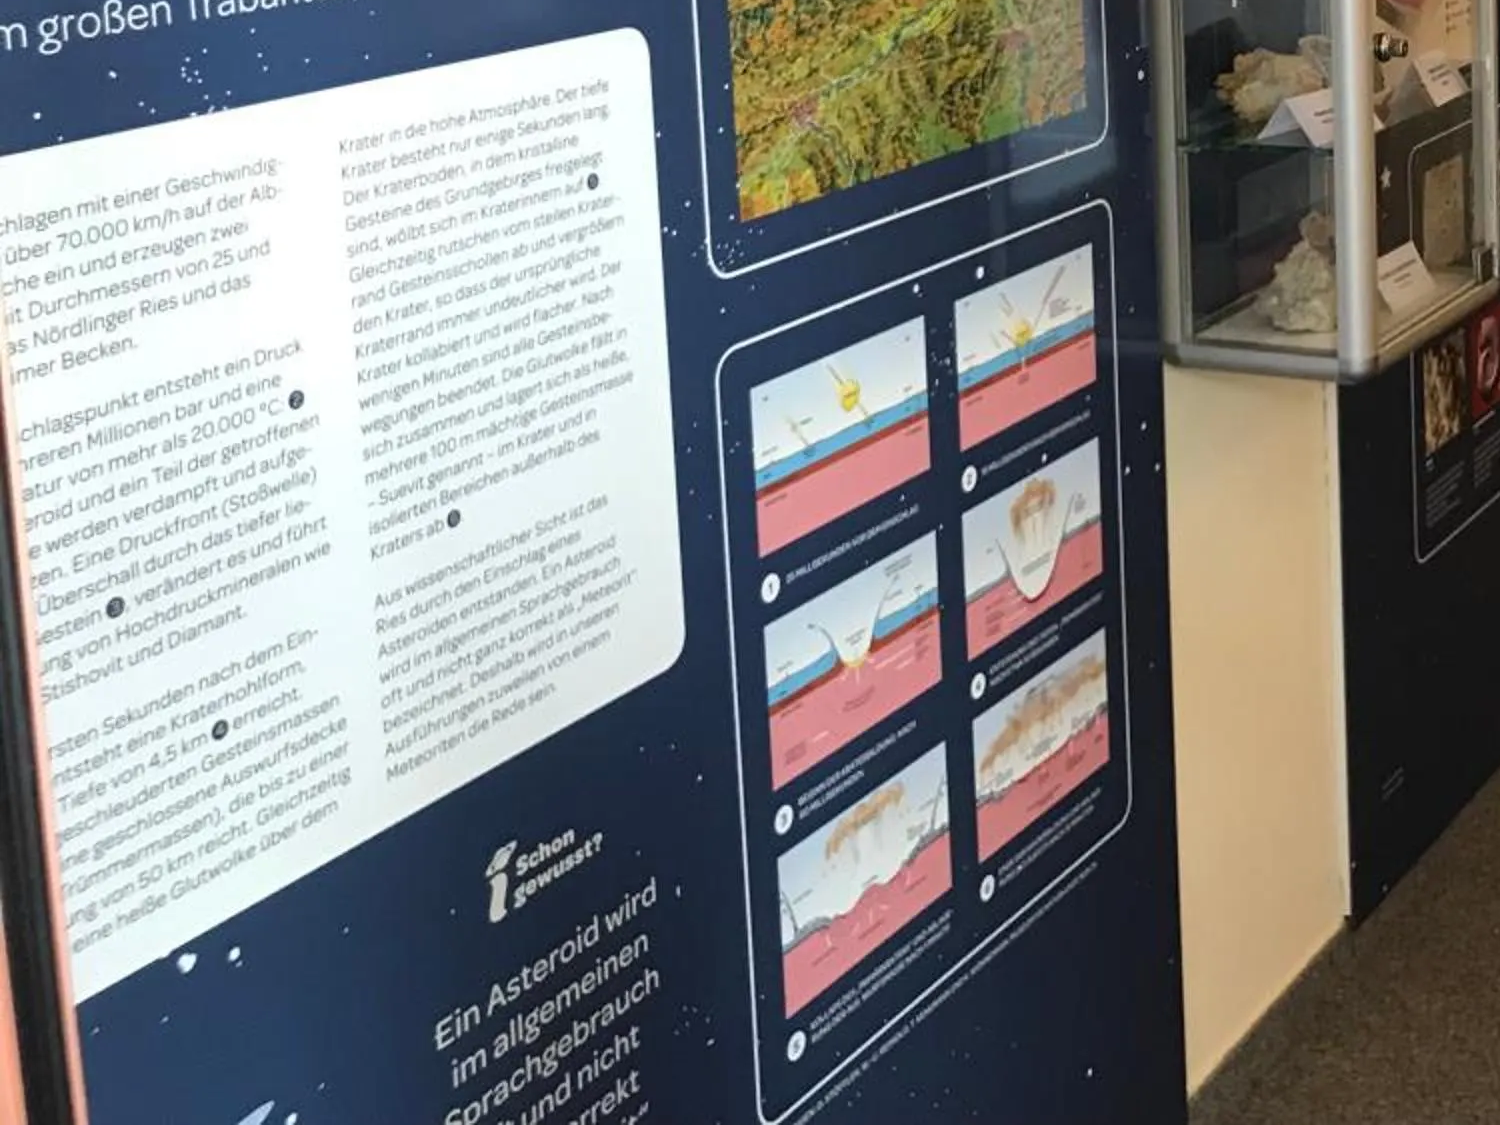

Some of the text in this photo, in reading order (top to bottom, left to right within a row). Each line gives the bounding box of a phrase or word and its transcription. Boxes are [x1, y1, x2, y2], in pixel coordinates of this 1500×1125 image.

[0, 158, 284, 237] hlagen mit einer Geschwindig-
[5, 241, 52, 266] über
[55, 218, 129, 252] 70.000
[132, 208, 181, 233] km/h
[183, 196, 212, 221] auf
[216, 193, 245, 213] der
[28, 268, 172, 321] Durchmessern
[175, 258, 209, 280] von
[212, 248, 235, 270] 25
[237, 239, 271, 263] und
[43, 265, 75, 286] ein
[79, 250, 117, 277] und
[120, 231, 206, 265] erzeugen
[210, 221, 249, 243] zwei
[32, 307, 135, 348] Nördlinger
[139, 295, 179, 318] Ries
[182, 282, 217, 306] und
[219, 274, 252, 295] das
[60, 337, 138, 371] Becken.
[143, 365, 220, 403] entsteht
[223, 357, 251, 377] ein
[253, 339, 302, 368] Druck
[67, 463, 105, 487] von
[107, 443, 158, 473] mehr
[161, 433, 188, 454] als
[190, 407, 256, 444] 20.000
[86, 411, 171, 451] Millionen
[174, 400, 203, 422] bar
[208, 383, 243, 410] und
[245, 374, 282, 397] eine
[45, 446, 312, 553] werden verdampft und aufge-
[77, 484, 116, 513] und
[118, 476, 149, 498] ein
[151, 459, 183, 484] Teil
[187, 450, 217, 473] der
[220, 414, 320, 466] getroffenen
[72, 546, 116, 574] Eine
[118, 505, 218, 556] Druckfront
[221, 466, 317, 519] (Stoßwelle)
[143, 541, 199, 575] durch
[201, 528, 233, 551] das
[236, 509, 281, 538] tiefer
[374, 588, 403, 609] Aus
[586, 494, 609, 514] das
[375, 530, 582, 635] Ries durch den Einschlag eines
[513, 832, 603, 909] gewusst?
[515, 829, 575, 876] Schon
[434, 876, 657, 1051] Ein Asteroid wird
[444, 968, 659, 1125] Sprachgebrauch
[451, 934, 649, 1088] im allgemeinen
[521, 1026, 641, 1125] und nicht
[569, 1070, 640, 1125] rrekt
